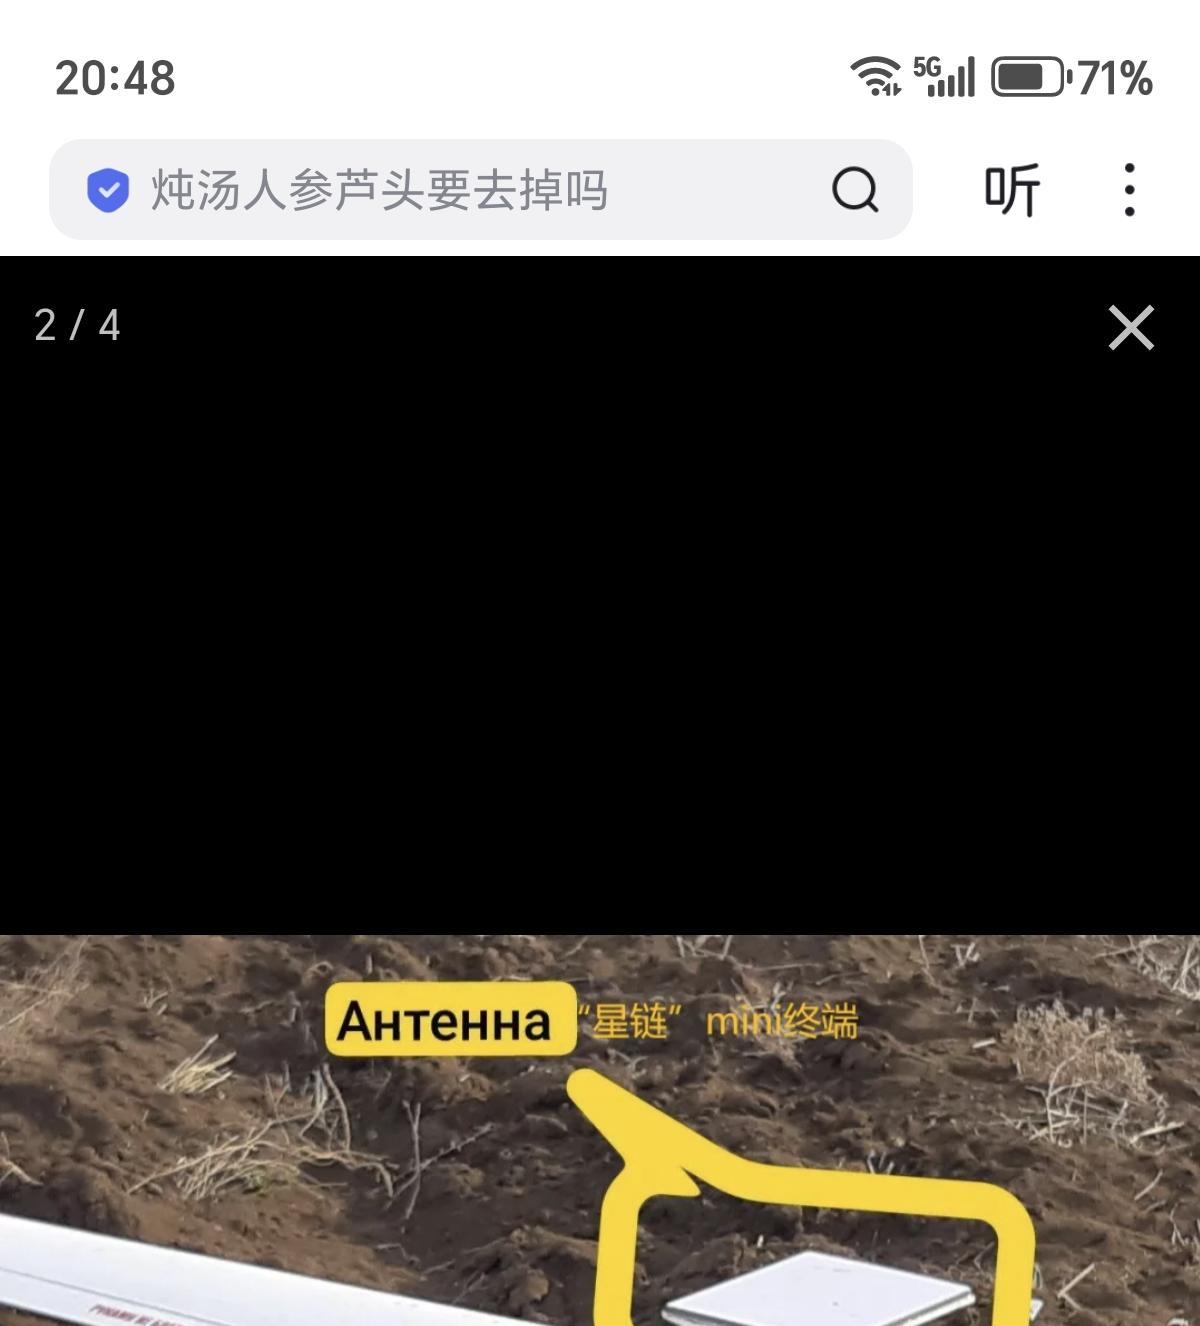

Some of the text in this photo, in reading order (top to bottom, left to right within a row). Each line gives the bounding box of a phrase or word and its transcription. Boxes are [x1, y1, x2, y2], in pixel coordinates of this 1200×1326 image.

[55, 59, 175, 96] 20:48
[913, 55, 942, 78] 5G
[1077, 59, 1154, 96] 71%
[151, 167, 608, 212] 炖汤人参芦头要去掉吗
[985, 162, 1041, 218] 听
